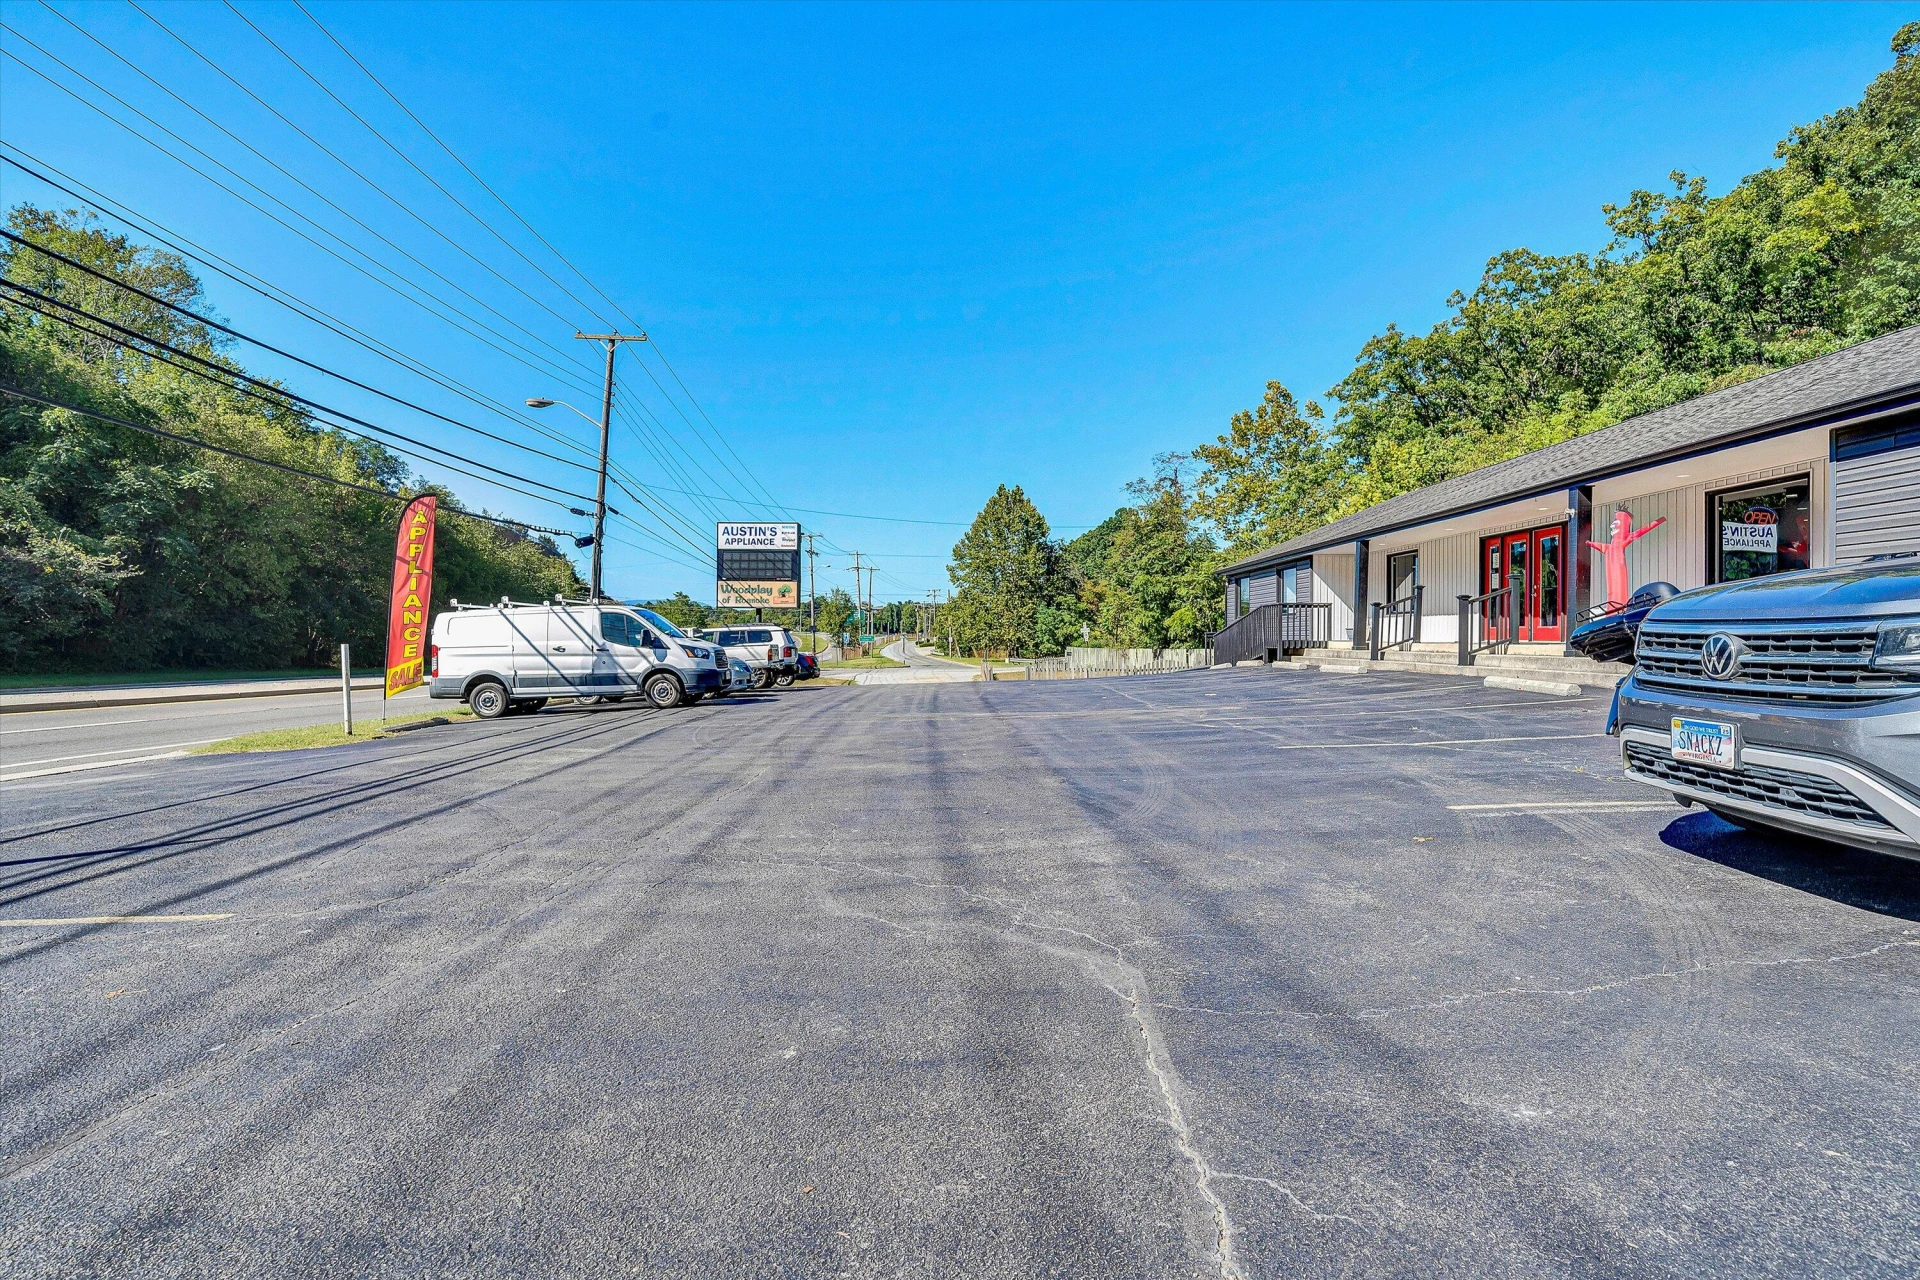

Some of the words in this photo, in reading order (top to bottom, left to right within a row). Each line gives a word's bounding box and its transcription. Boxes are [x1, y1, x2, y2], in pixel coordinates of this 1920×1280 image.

[1744, 511, 1776, 525] OPEN
[721, 526, 778, 537] AUSTIN'S
[724, 537, 775, 546] APPLIANCE
[401, 509, 427, 659] APPLIANCE
[720, 584, 773, 597] Woodplay
[722, 596, 731, 604] of
[735, 596, 770, 604] Roanoke
[388, 661, 423, 692] SALE
[1678, 730, 1723, 756] SNACKZ
[1687, 751, 1718, 763] VIRGINIA
